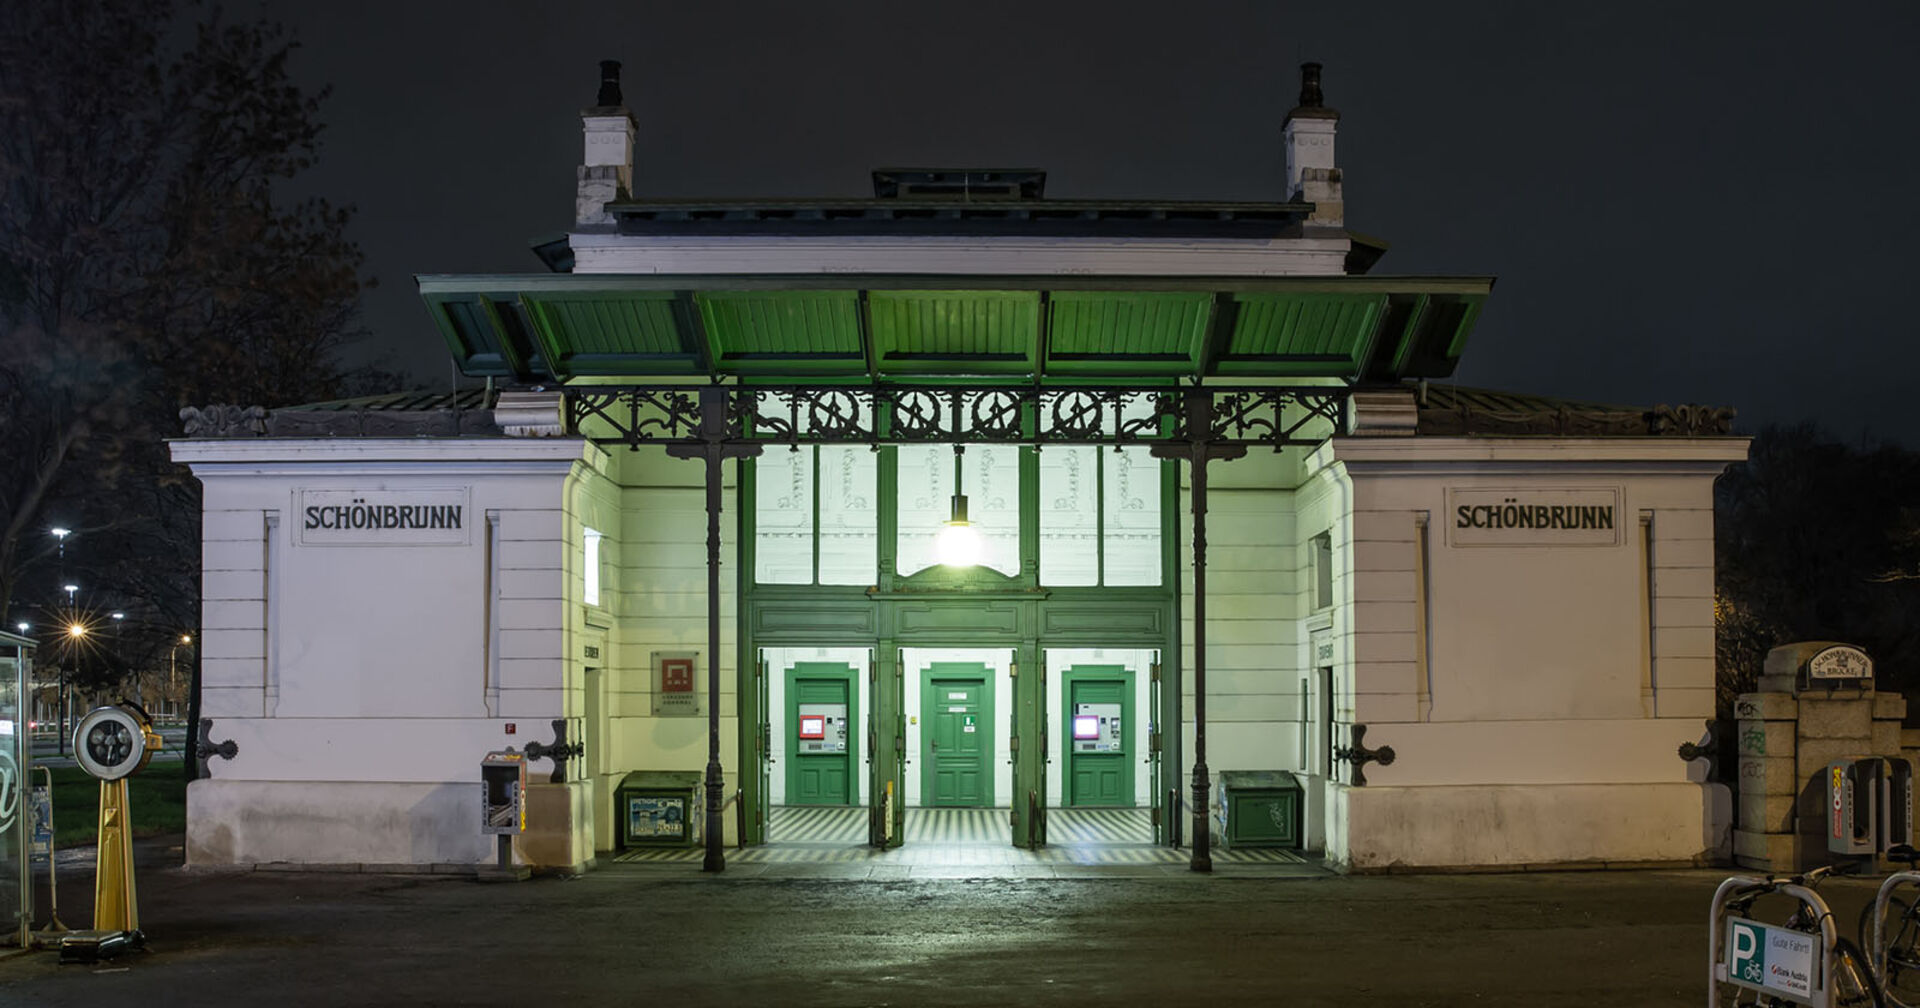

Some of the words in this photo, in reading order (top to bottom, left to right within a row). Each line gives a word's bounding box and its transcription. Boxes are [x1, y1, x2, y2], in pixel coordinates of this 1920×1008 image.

[305, 498, 462, 529] SCHÖNBRUNN
[1457, 498, 1613, 529] SCHÖNBRUNN
[1731, 923, 1757, 976] P
